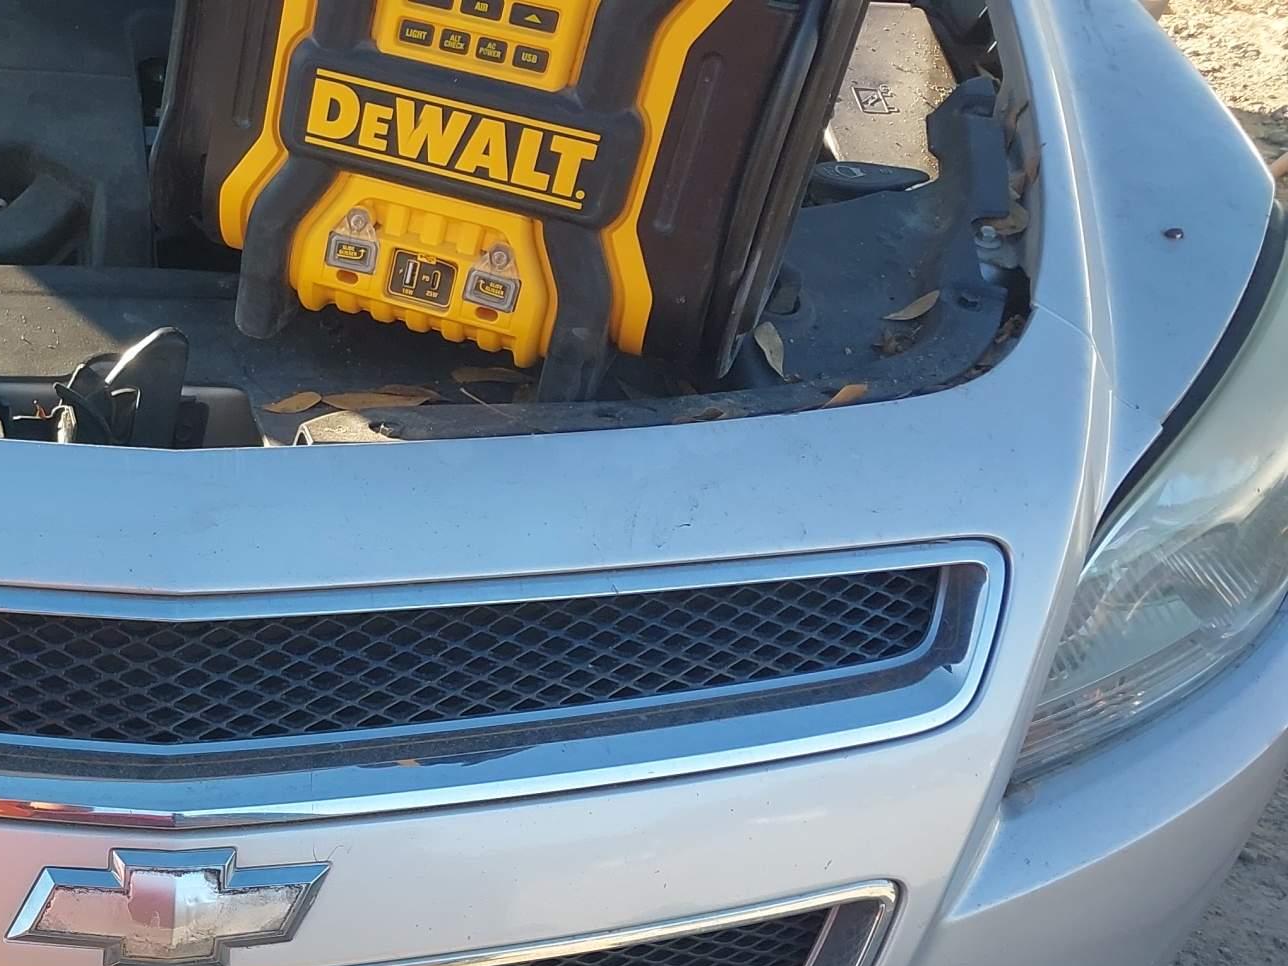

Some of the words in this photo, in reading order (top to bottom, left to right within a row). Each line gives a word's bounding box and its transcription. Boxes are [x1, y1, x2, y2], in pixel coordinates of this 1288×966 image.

[474, 1, 488, 12] AIR
[405, 28, 427, 41] LIGHT
[449, 33, 462, 43] ALT
[443, 39, 465, 50] CHECK
[486, 42, 497, 50] AC
[478, 47, 501, 59] POWER
[521, 52, 538, 64] USB
